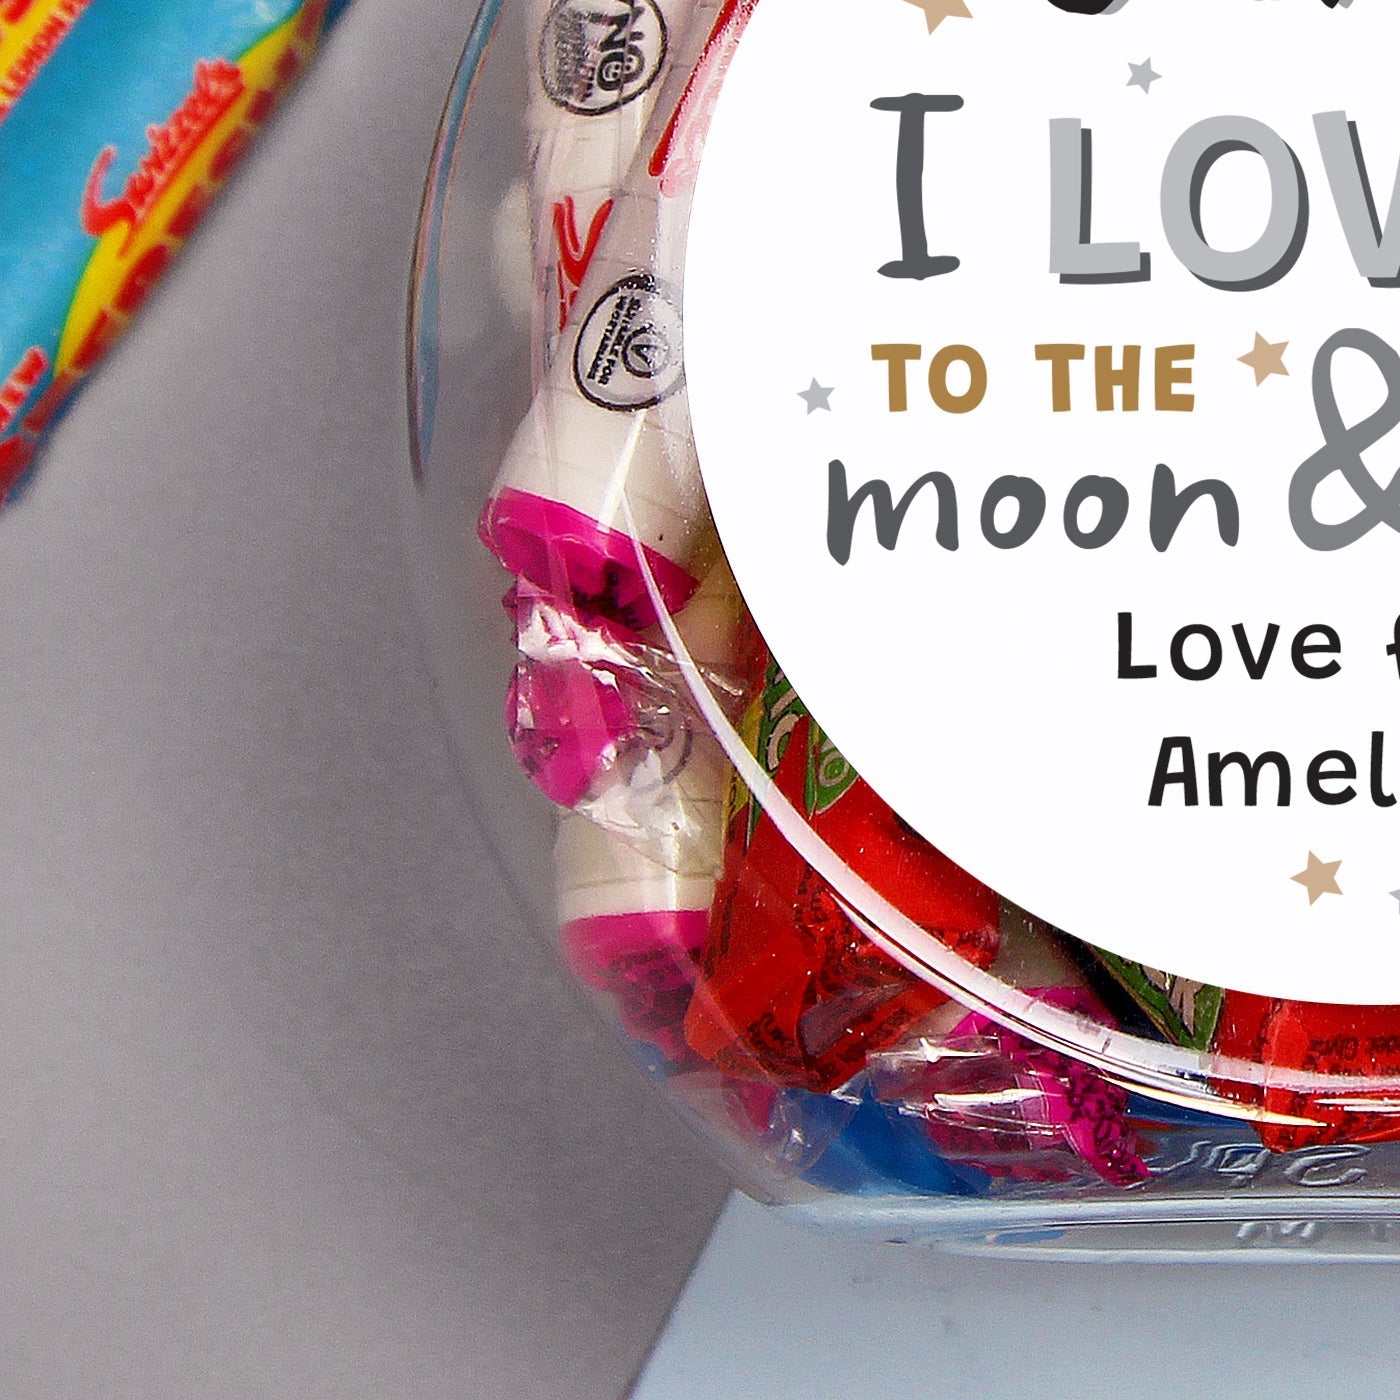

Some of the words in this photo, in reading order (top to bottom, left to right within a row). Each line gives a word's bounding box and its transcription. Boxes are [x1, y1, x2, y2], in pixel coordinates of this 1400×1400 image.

[869, 93, 964, 281] I
[871, 343, 988, 414] TO
[1034, 343, 1195, 414] THE
[826, 459, 1239, 566] moon
[1117, 612, 1342, 681] Love
